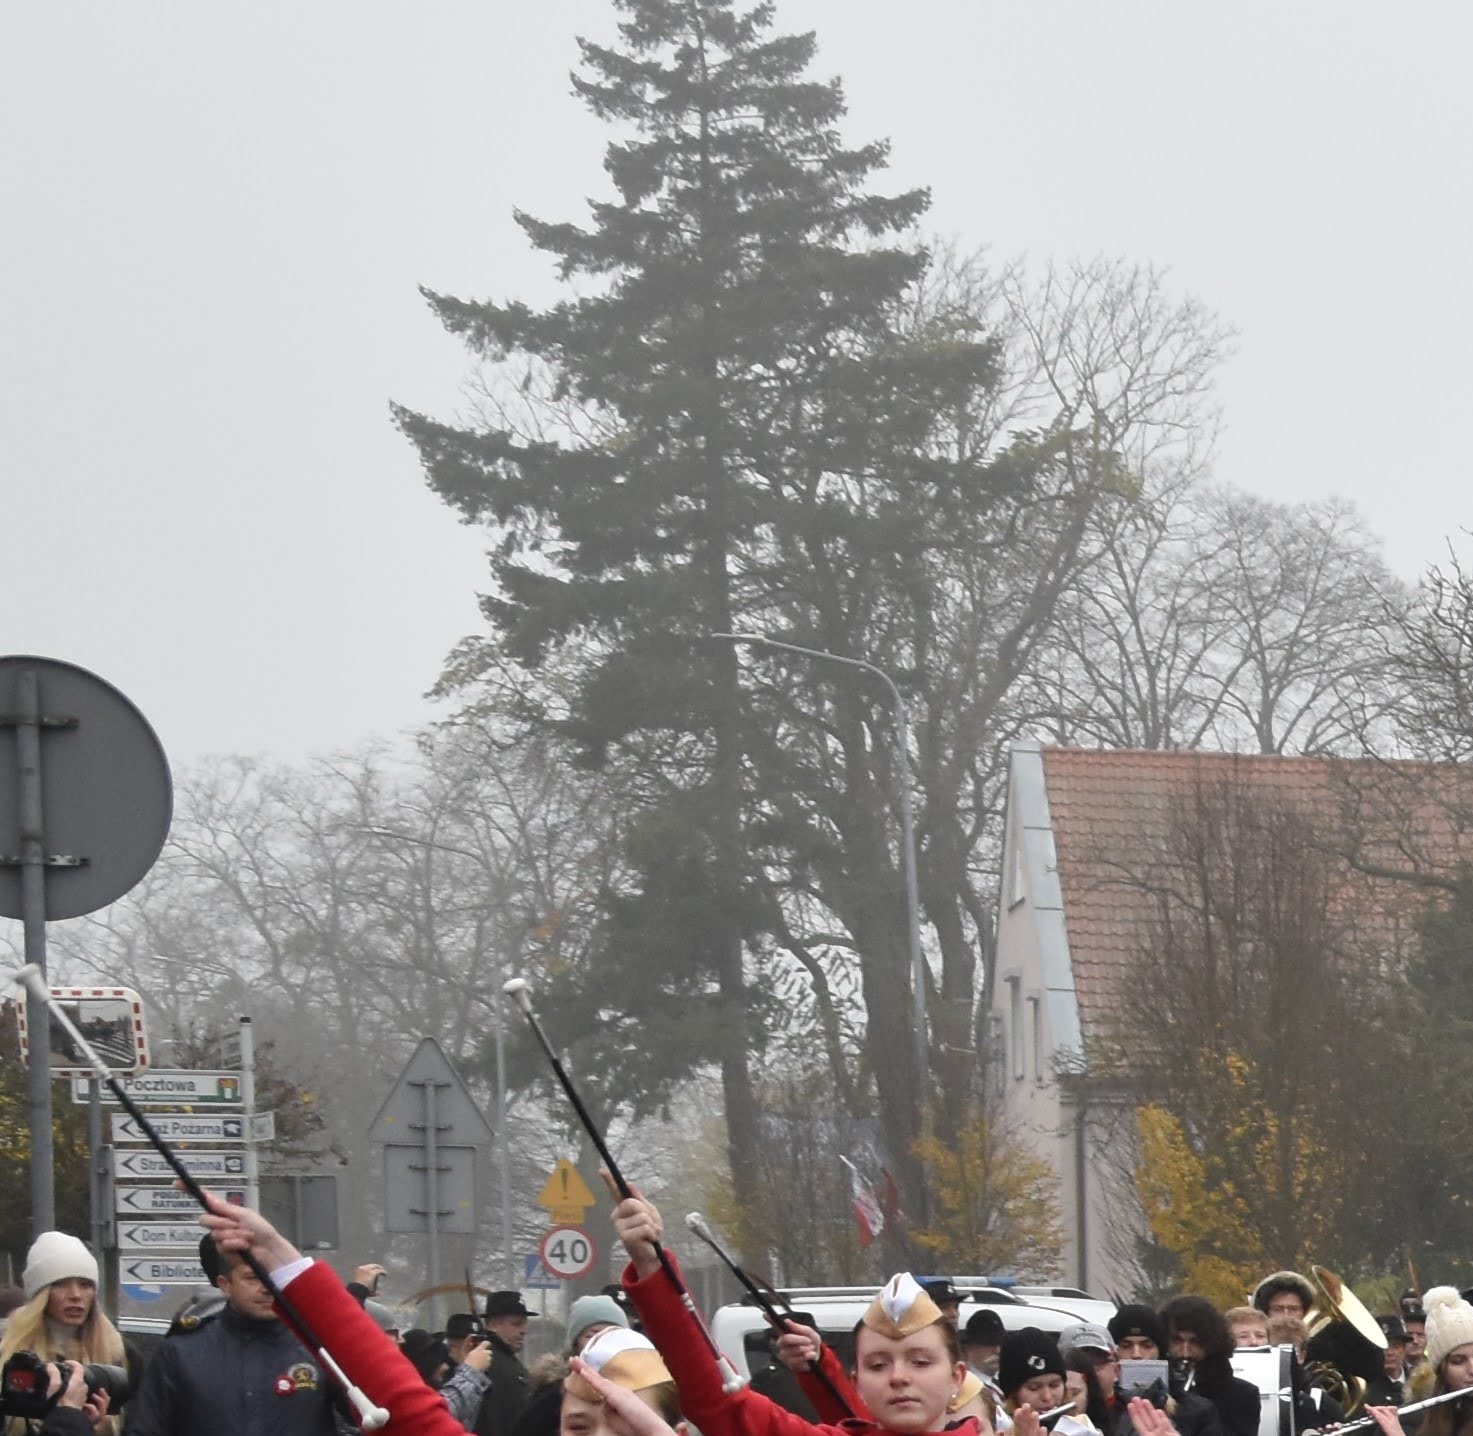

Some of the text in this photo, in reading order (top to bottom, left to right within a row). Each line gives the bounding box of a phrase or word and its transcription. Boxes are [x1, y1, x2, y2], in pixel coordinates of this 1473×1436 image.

[124, 1078, 196, 1092] Pocztowa
[176, 1157, 222, 1171] minna
[142, 1228, 203, 1242] Dom Kultur
[549, 1239, 588, 1264] 40
[151, 1264, 205, 1278] Bibliote
